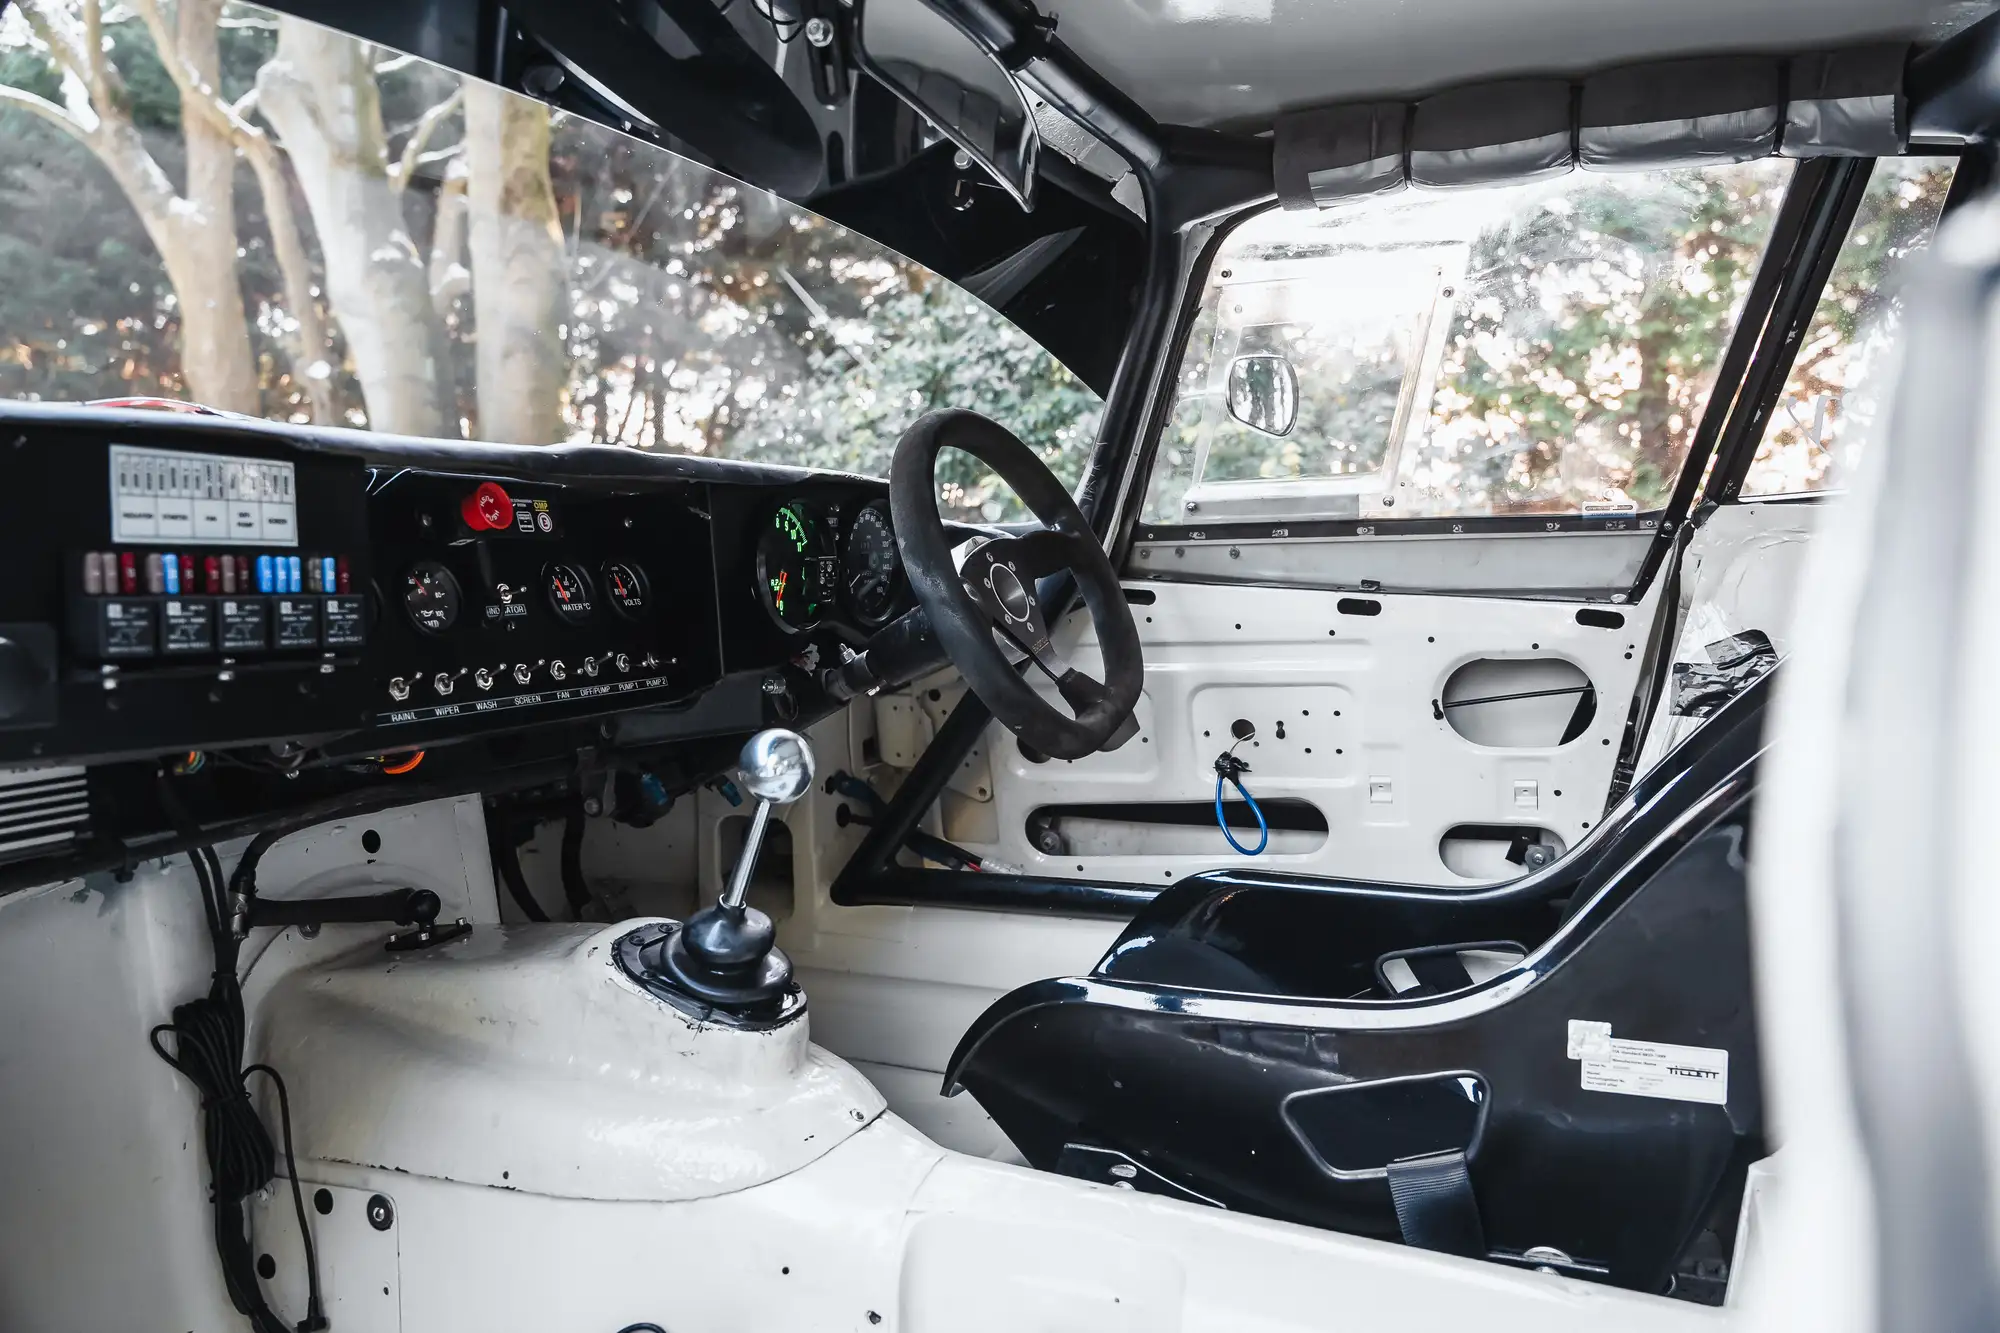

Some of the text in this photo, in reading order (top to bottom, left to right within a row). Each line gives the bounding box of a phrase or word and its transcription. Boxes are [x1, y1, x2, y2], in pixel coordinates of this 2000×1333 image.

[533, 502, 548, 510] OMP
[485, 509, 500, 521] PUSH
[561, 603, 583, 611] WATER
[623, 598, 642, 606] VOLTS
[487, 605, 524, 615] INDATOR
[434, 706, 460, 716] WIPER
[475, 701, 498, 711] WASH
[514, 695, 541, 706] SCREEN
[556, 691, 570, 700] FAN
[580, 685, 611, 697] DIFF/PUMP
[618, 683, 634, 691] PUMP
[646, 679, 661, 687] PUMP
[1666, 1065, 1720, 1079] TILLETT
